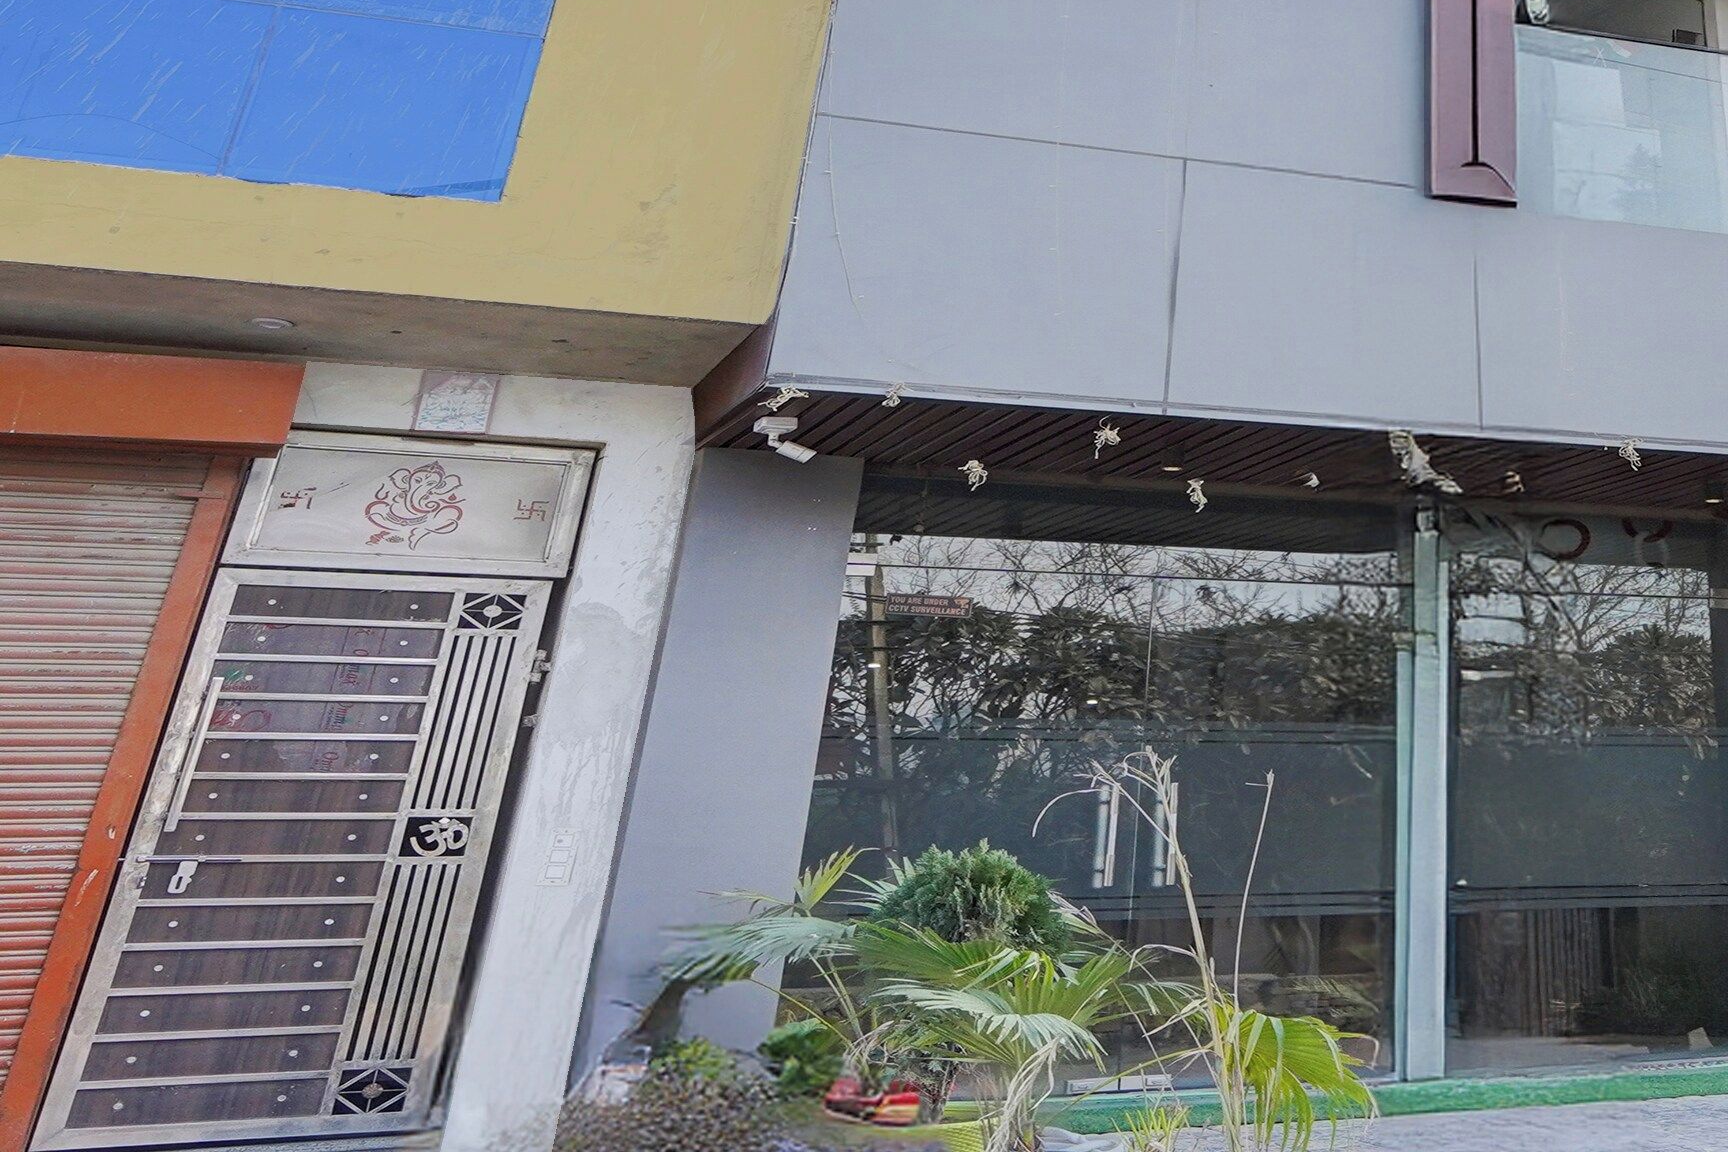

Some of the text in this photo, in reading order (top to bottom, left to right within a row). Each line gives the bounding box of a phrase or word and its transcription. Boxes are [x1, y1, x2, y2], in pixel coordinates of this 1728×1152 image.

[891, 596, 949, 606] YOU ARE UNDER
[888, 604, 967, 616] CCTV SURVEILLANCE
